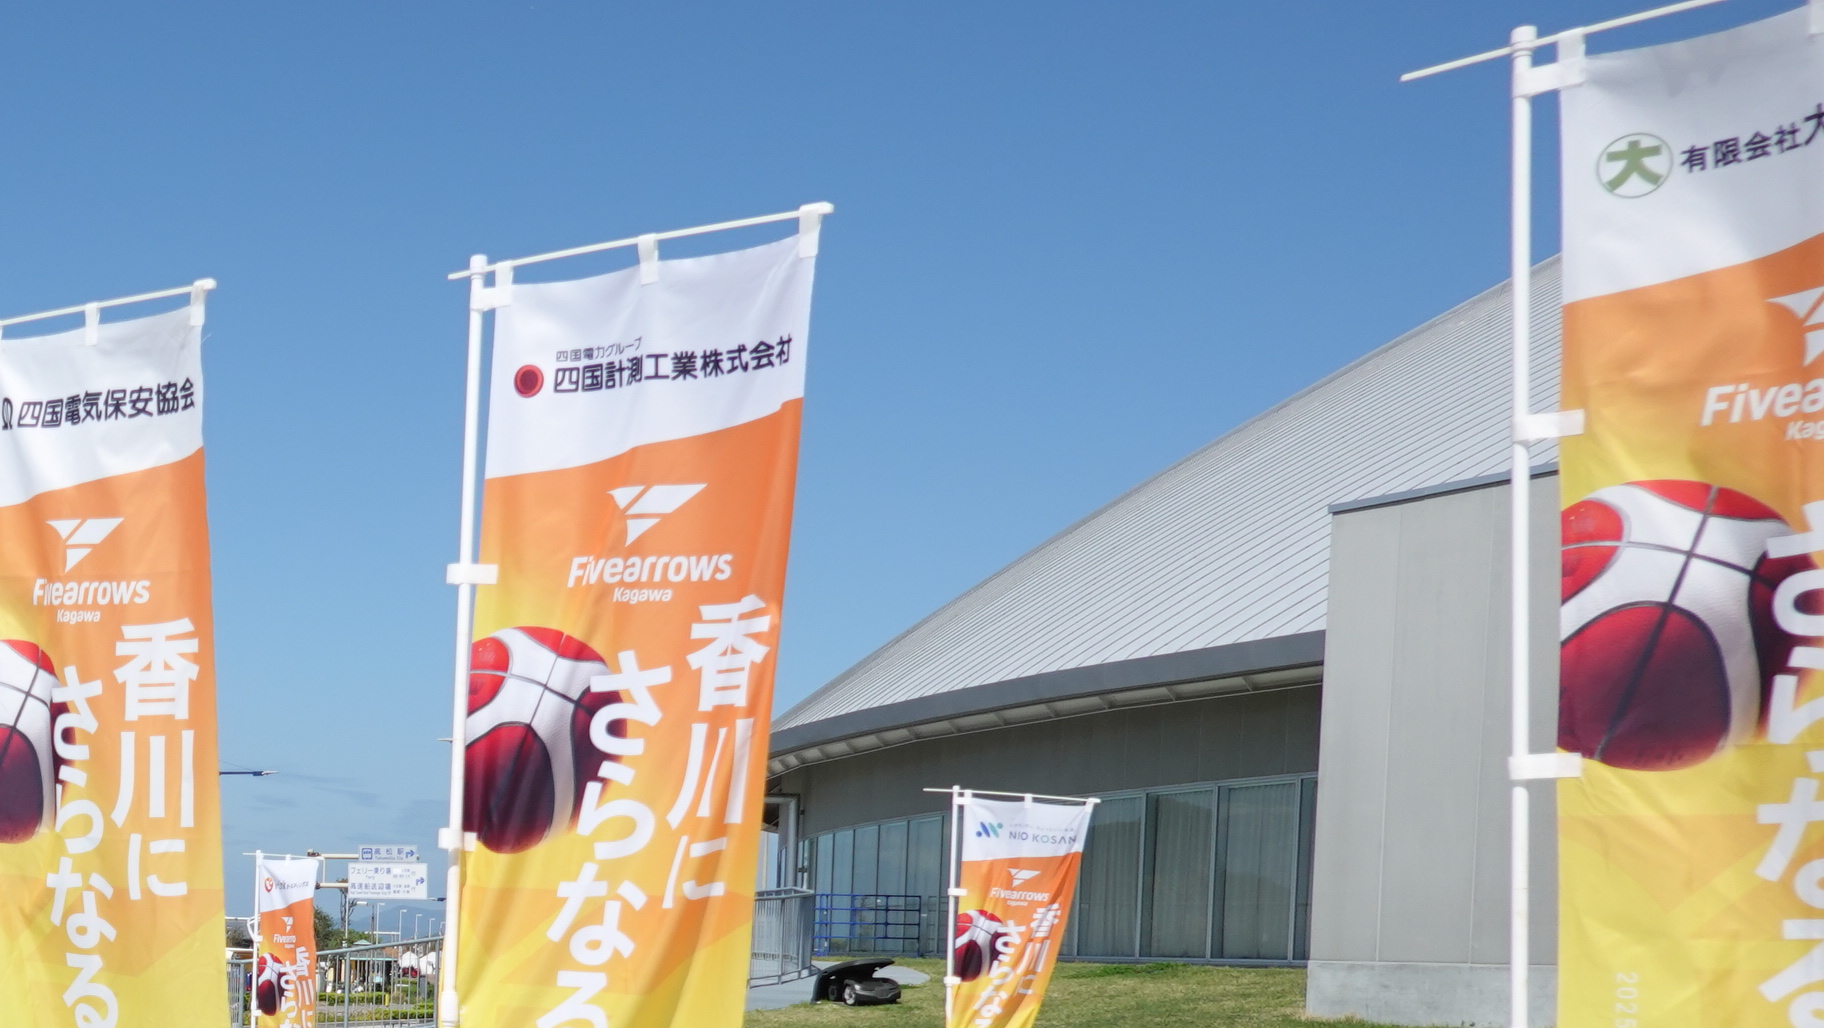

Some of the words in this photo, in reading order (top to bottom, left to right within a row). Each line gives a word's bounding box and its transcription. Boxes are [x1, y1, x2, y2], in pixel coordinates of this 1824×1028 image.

[553, 333, 793, 394] 四国計測工業株式会社
[555, 336, 642, 362] 四国電力グループ
[17, 376, 196, 429] 四国電気保安協会
[566, 553, 733, 589] Fivearrows
[33, 577, 150, 607] Fivearrows
[613, 587, 672, 606] Kagawa
[56, 608, 101, 625] Kagawa
[110, 617, 200, 901] 香川に
[662, 594, 772, 909] 香川に
[990, 886, 1051, 902] Fivearrows
